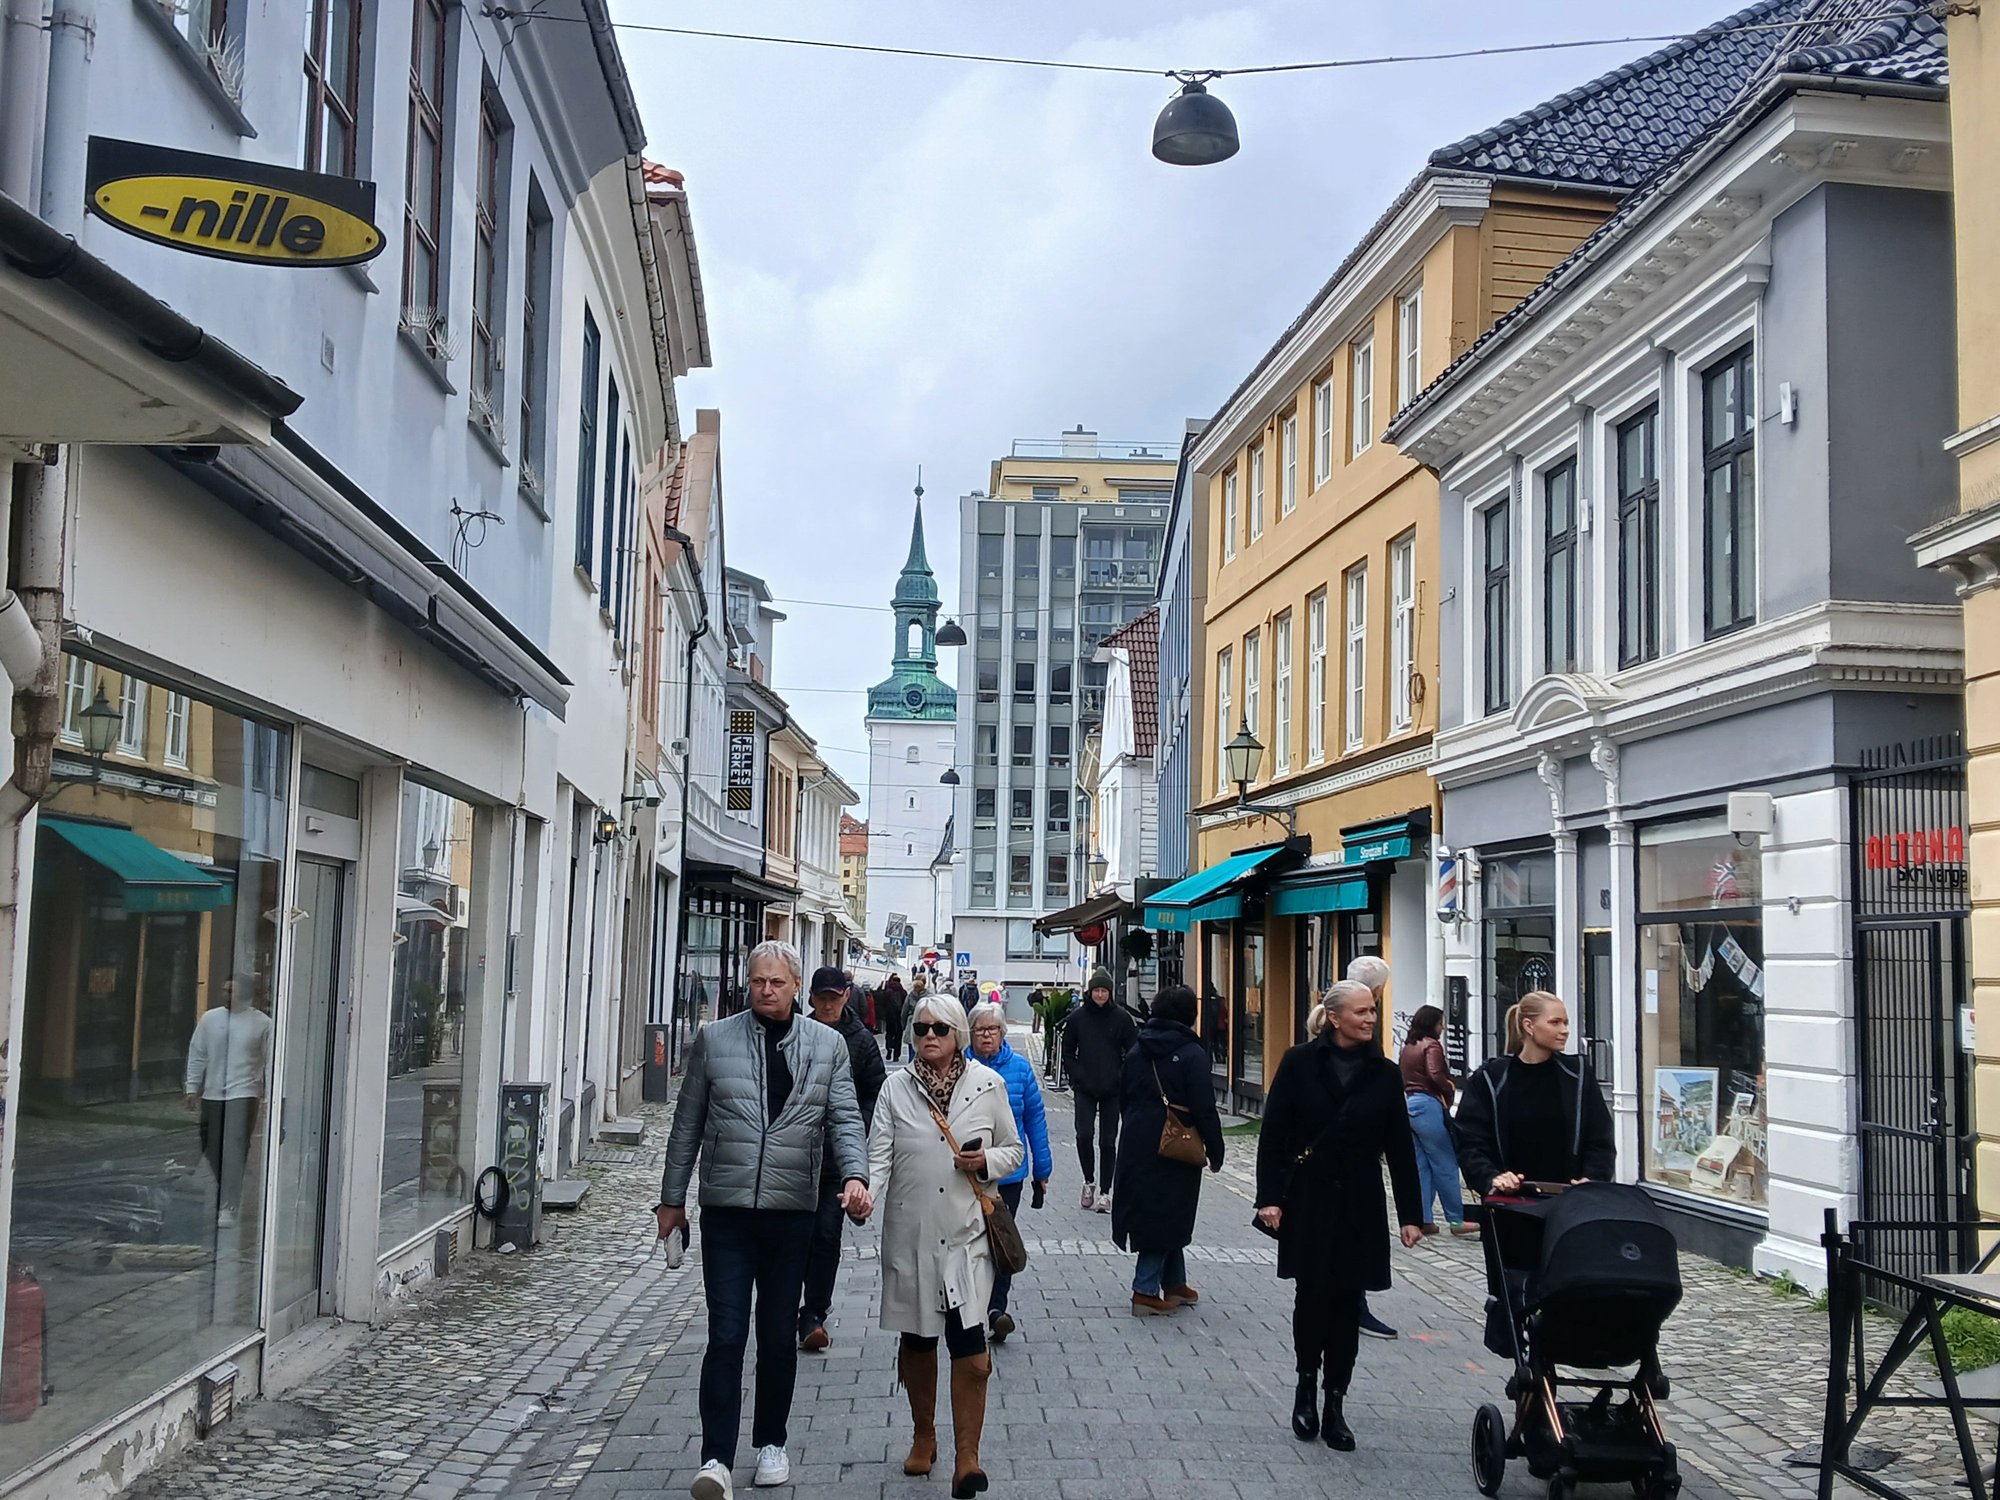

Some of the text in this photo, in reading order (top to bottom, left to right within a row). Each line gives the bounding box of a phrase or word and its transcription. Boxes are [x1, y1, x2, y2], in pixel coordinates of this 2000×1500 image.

[730, 736, 741, 785] VERKET
[741, 736, 752, 785] FELLES
[1867, 826, 1963, 870] ALTONA
